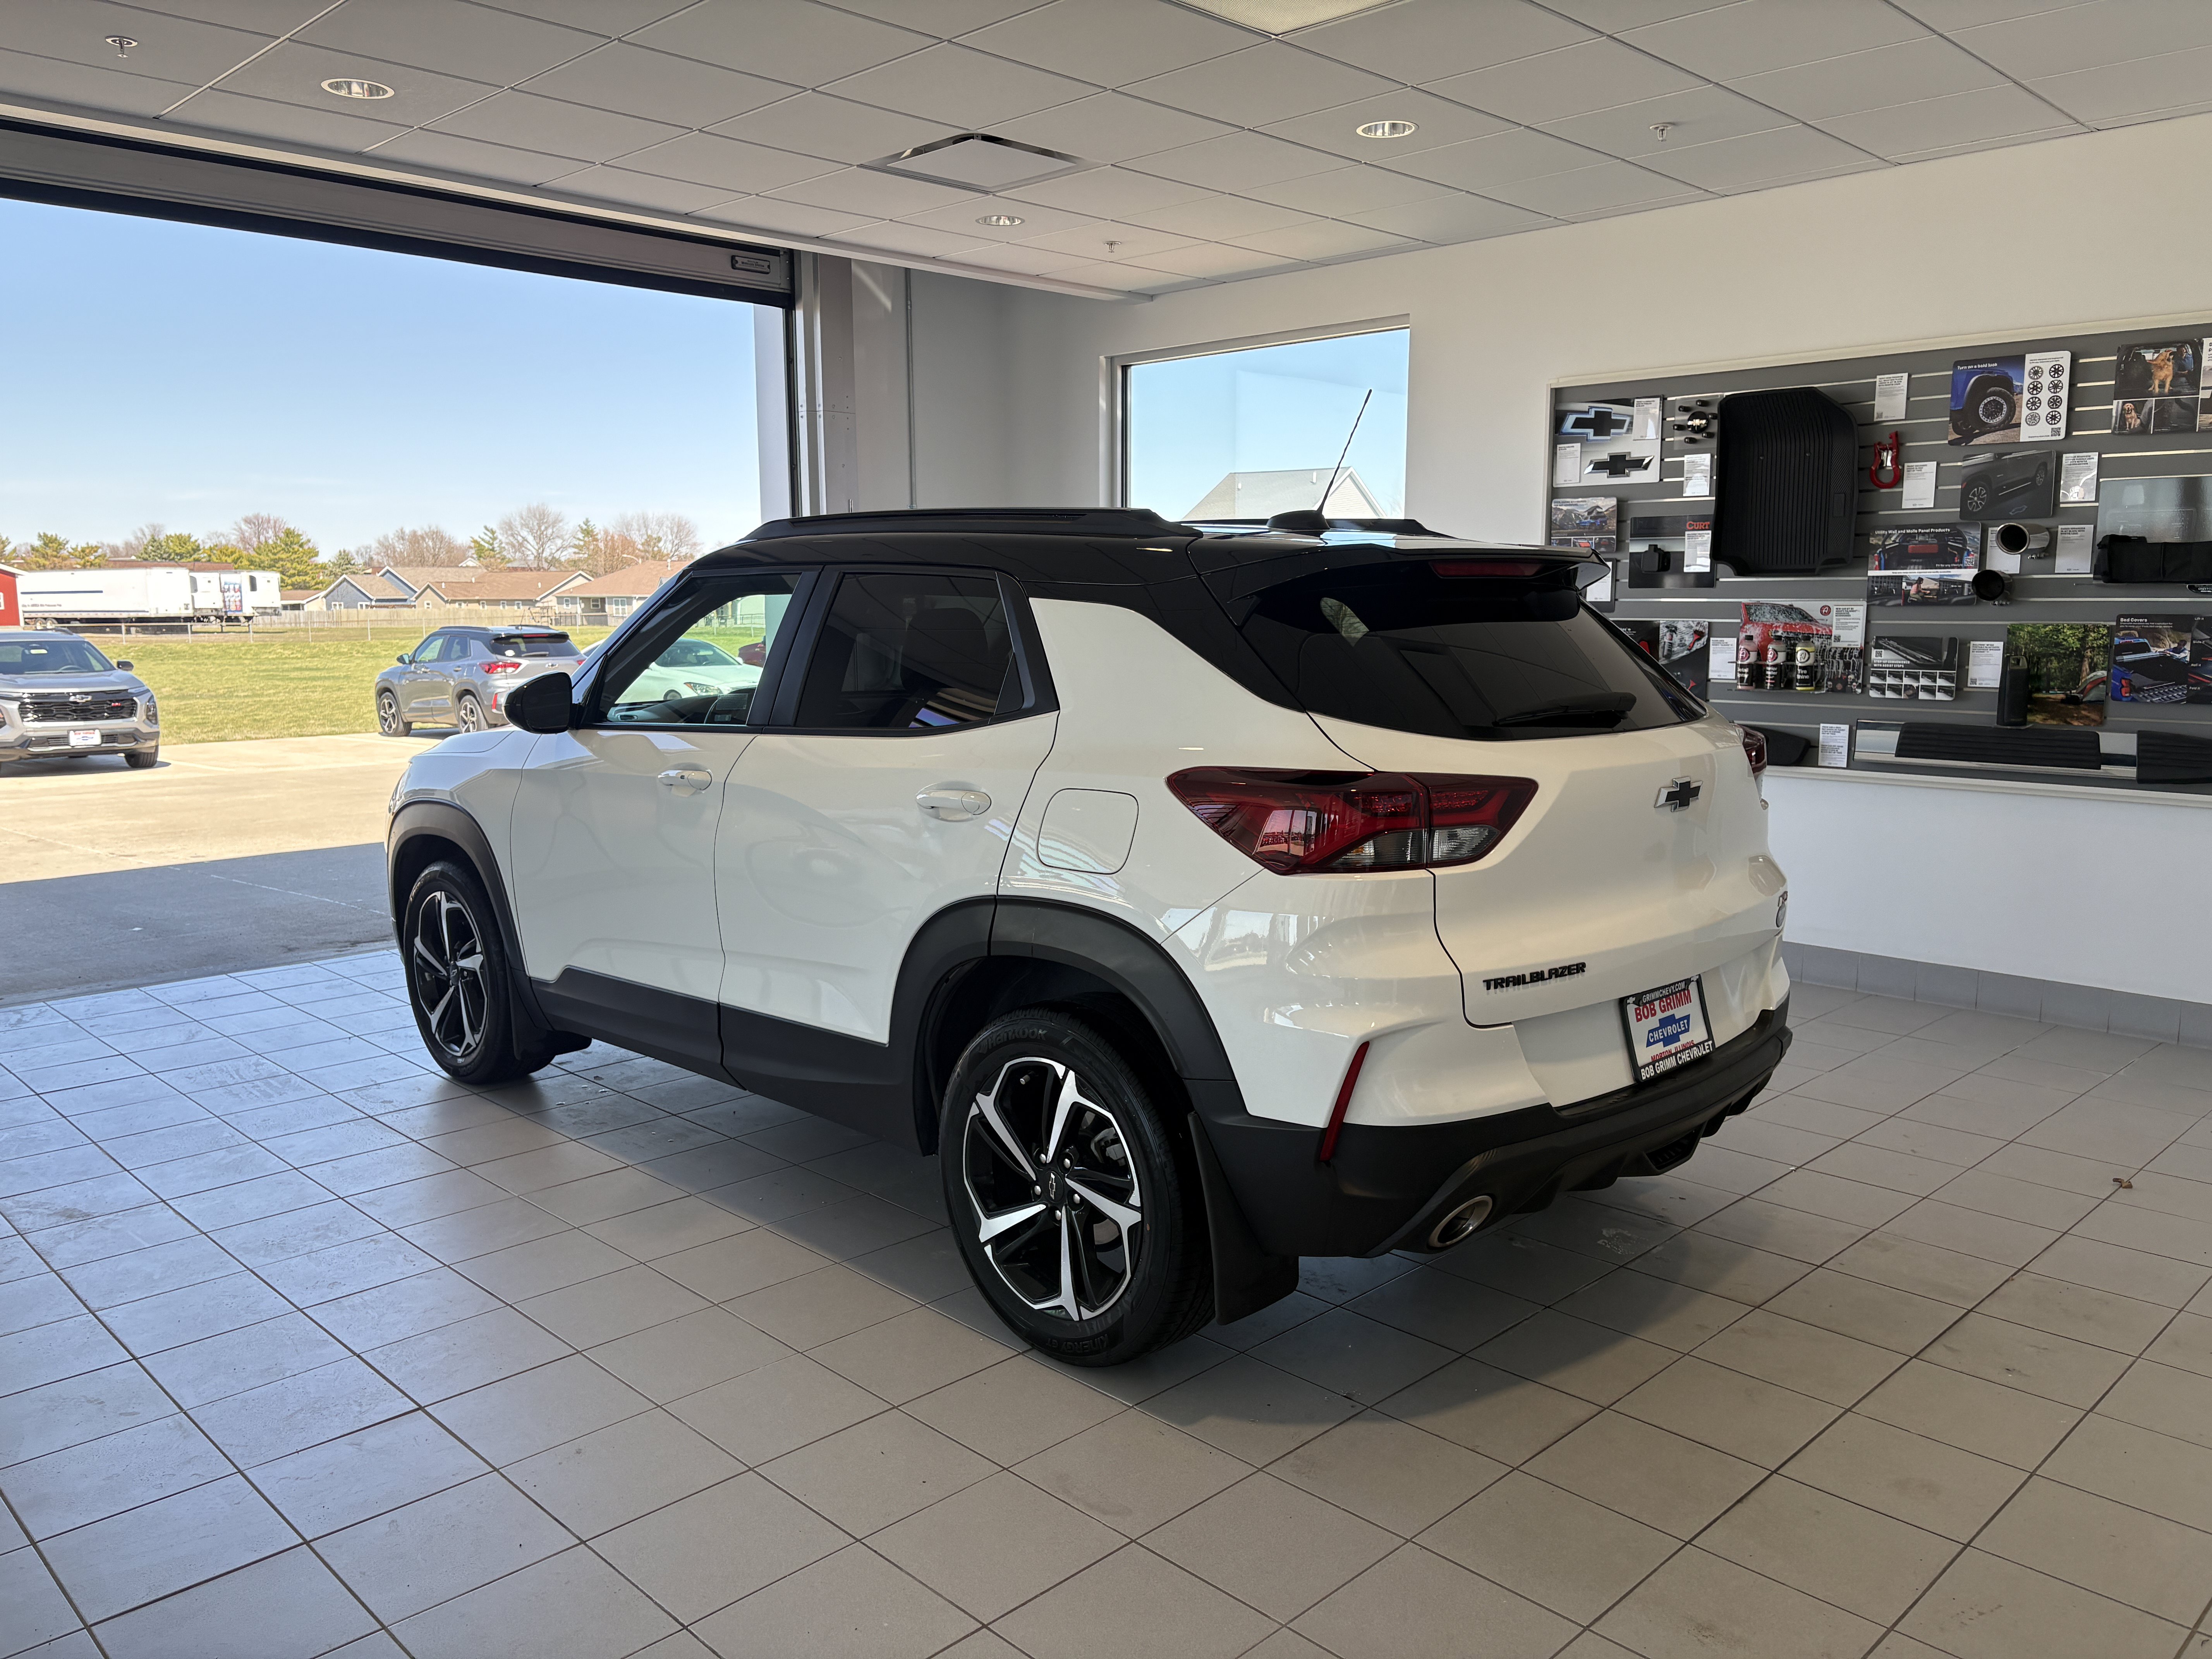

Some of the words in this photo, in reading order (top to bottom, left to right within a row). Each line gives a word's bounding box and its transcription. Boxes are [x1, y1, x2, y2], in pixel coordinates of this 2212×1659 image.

[1686, 521, 1710, 530] CURT
[1483, 962, 1586, 990] TRAILBLAZER
[1642, 981, 1685, 1003] GRIMMCHEVY.COM
[1634, 1002, 1657, 1022] BOB
[1659, 989, 1692, 1013] GRIMM
[1649, 1019, 1688, 1042] CHEVROLET
[1641, 1065, 1655, 1080] BOB
[1655, 1057, 1676, 1074] GRIMM
[1677, 1041, 1713, 1065] CHEVROLET
[1651, 1048, 1672, 1062] MORTON
[1674, 1040, 1695, 1054] ILLINOIS
